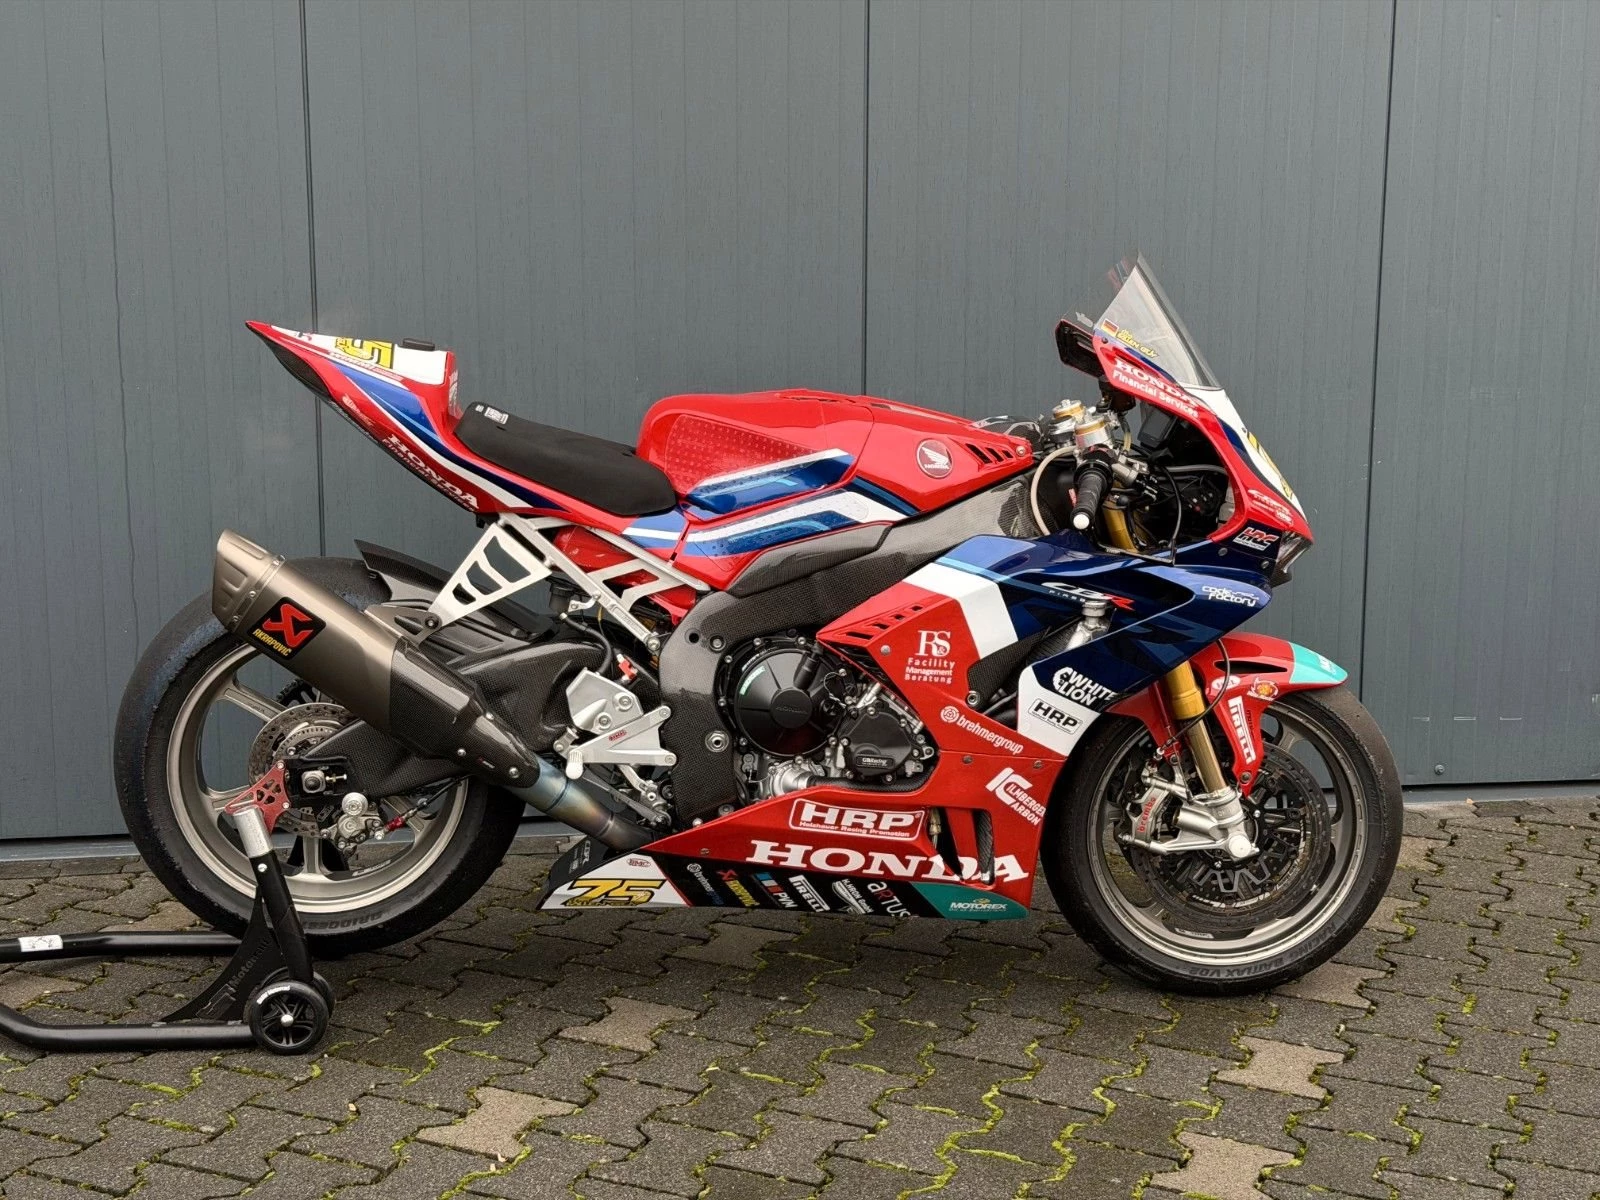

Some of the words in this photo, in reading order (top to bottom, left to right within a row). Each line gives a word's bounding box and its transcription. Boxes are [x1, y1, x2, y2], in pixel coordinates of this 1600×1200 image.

[1112, 370, 1157, 397] Financial
[1158, 391, 1199, 418] Services
[1115, 356, 1199, 408] HONDA
[388, 434, 480, 510] HONDA
[904, 673, 952, 684] Beratung
[905, 666, 953, 676] Management
[908, 657, 956, 669] Facility
[1059, 681, 1098, 706] LION
[1068, 670, 1119, 701] WHITE
[1034, 702, 1078, 727] HRP
[1227, 695, 1256, 765] PIRELLI
[957, 715, 1024, 755] brehmergroup
[800, 802, 915, 831] HRP
[1137, 797, 1157, 833] brembo
[841, 826, 867, 834] Racing
[869, 828, 910, 837] Promotion
[746, 839, 1029, 883] HONDA
[561, 878, 667, 907] 75
[788, 874, 831, 913] PIRELLI
